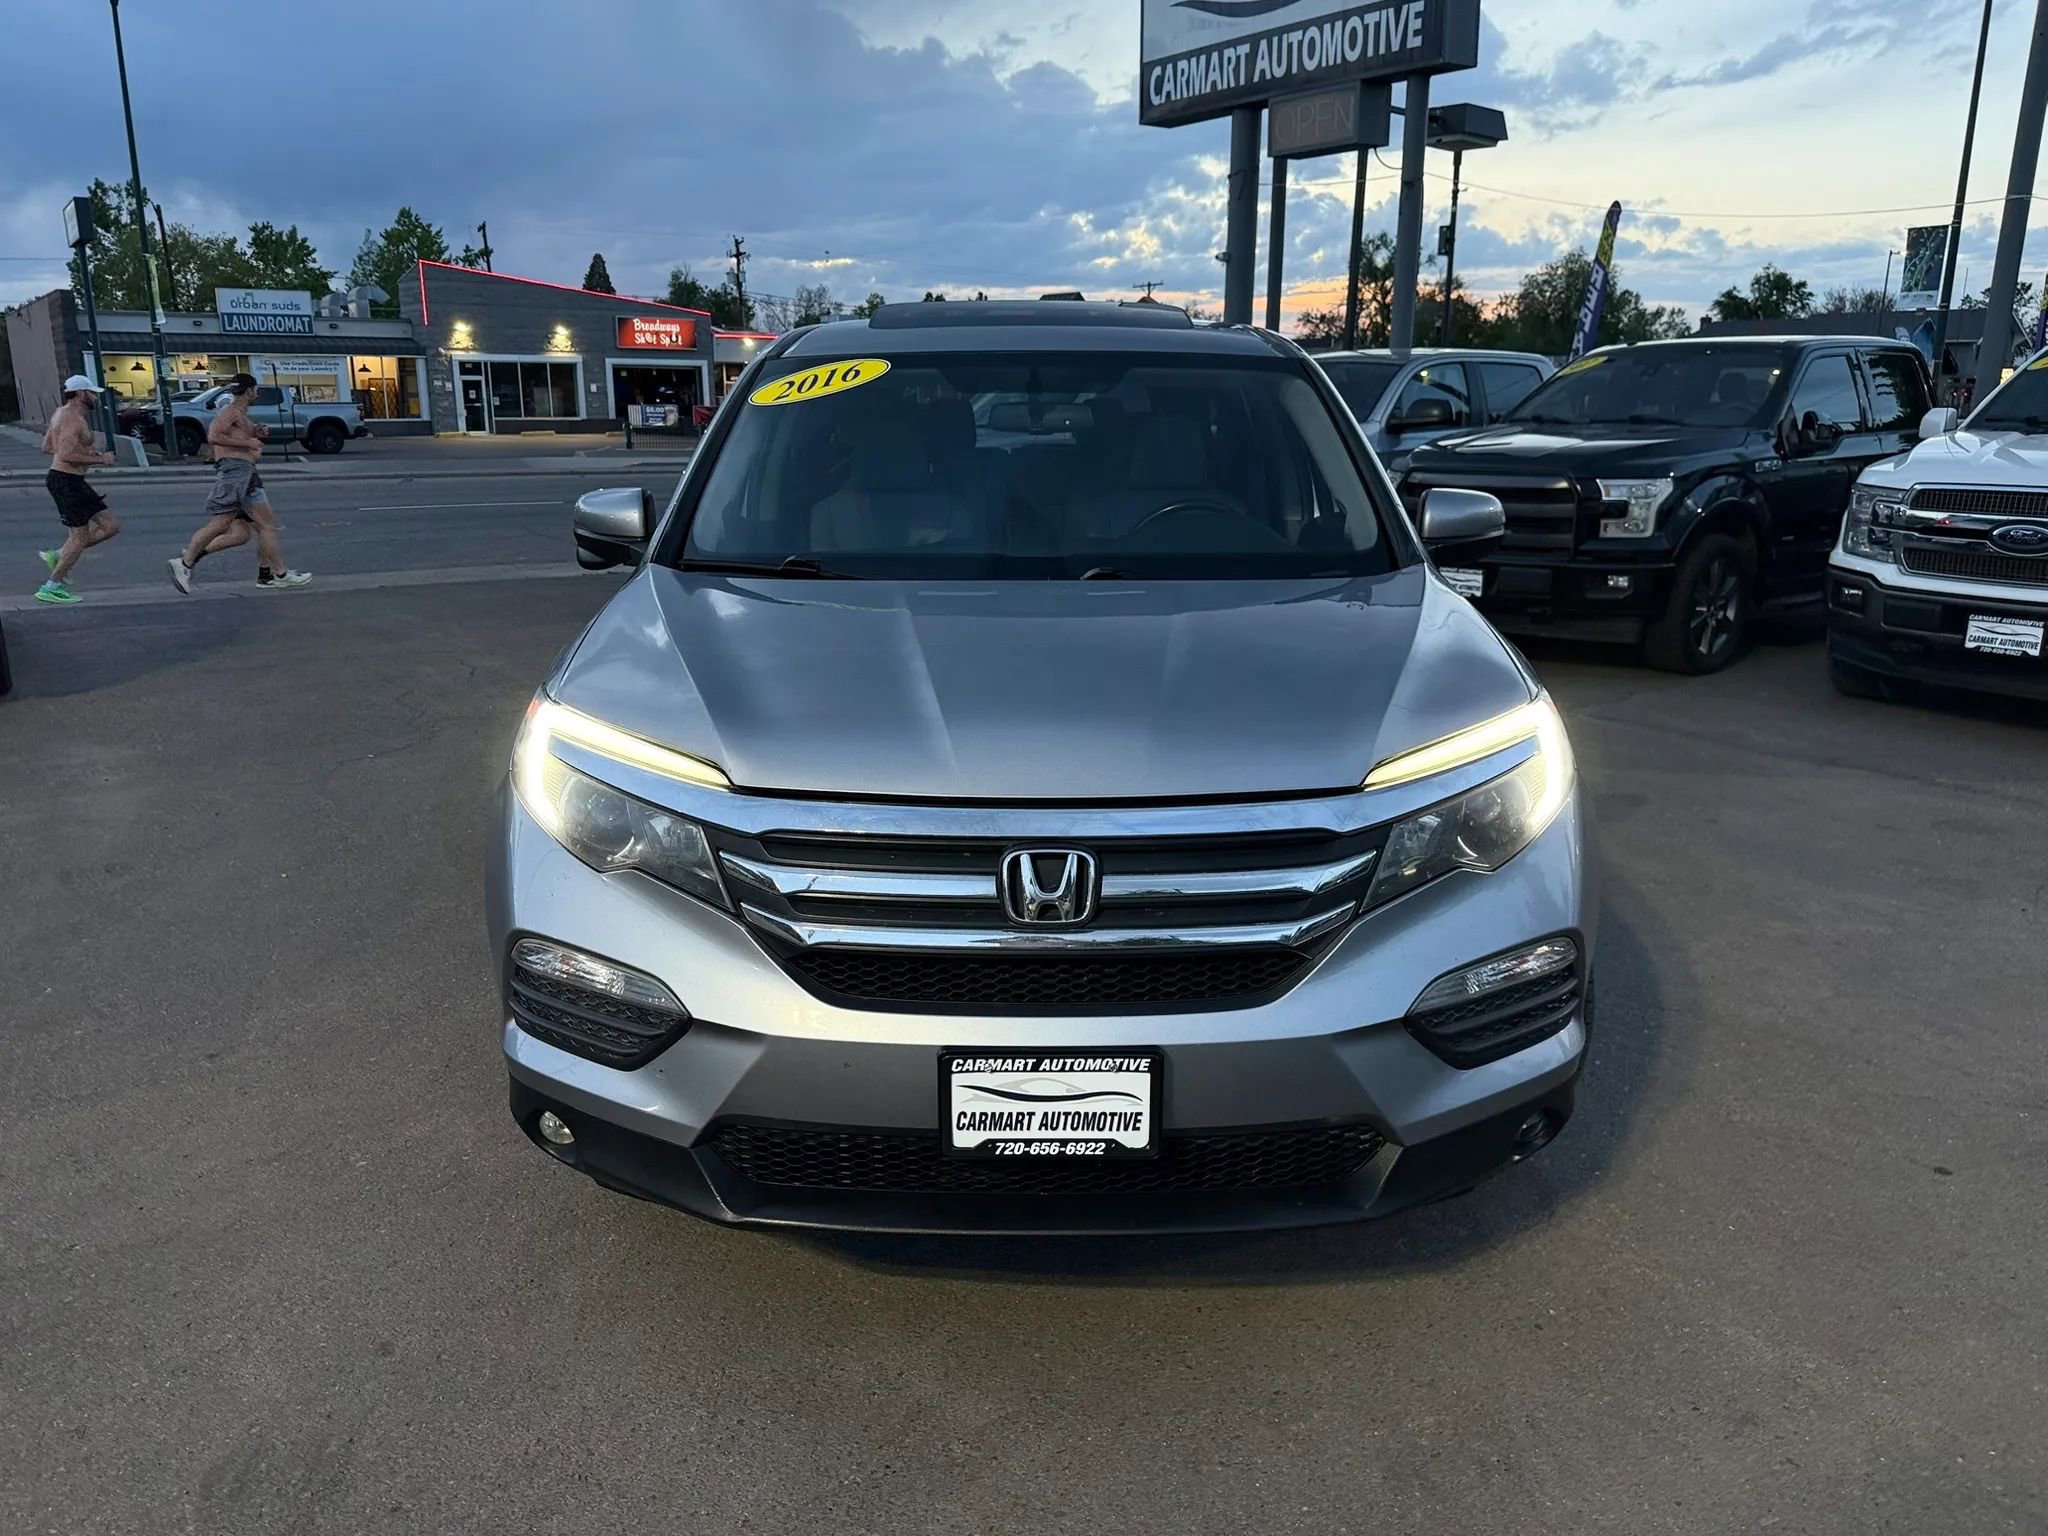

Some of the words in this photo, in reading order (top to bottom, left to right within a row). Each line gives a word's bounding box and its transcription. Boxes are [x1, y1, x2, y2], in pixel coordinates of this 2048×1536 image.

[1150, 43, 1250, 106] CARMART
[1253, 0, 1425, 82] AUTOMOTIVE
[1274, 92, 1357, 144] OPEN
[230, 297, 267, 310] urban
[271, 301, 302, 311] suds
[223, 314, 310, 332] LAUNDROMAT
[772, 362, 864, 401] 2016
[1968, 614, 2001, 623] CARMART
[2001, 617, 2044, 627] AUTOMOTIVE
[1967, 634, 1999, 646] CARMART
[1998, 637, 2040, 650] AUTOMOTIVE
[951, 1058, 1036, 1072] CARMART
[1039, 1058, 1151, 1072] AUTOMOTIVE
[955, 1111, 1036, 1132] CARMART
[1038, 1111, 1144, 1132] AUTOMOTIVE
[994, 1142, 1106, 1155] 720-656-6922
